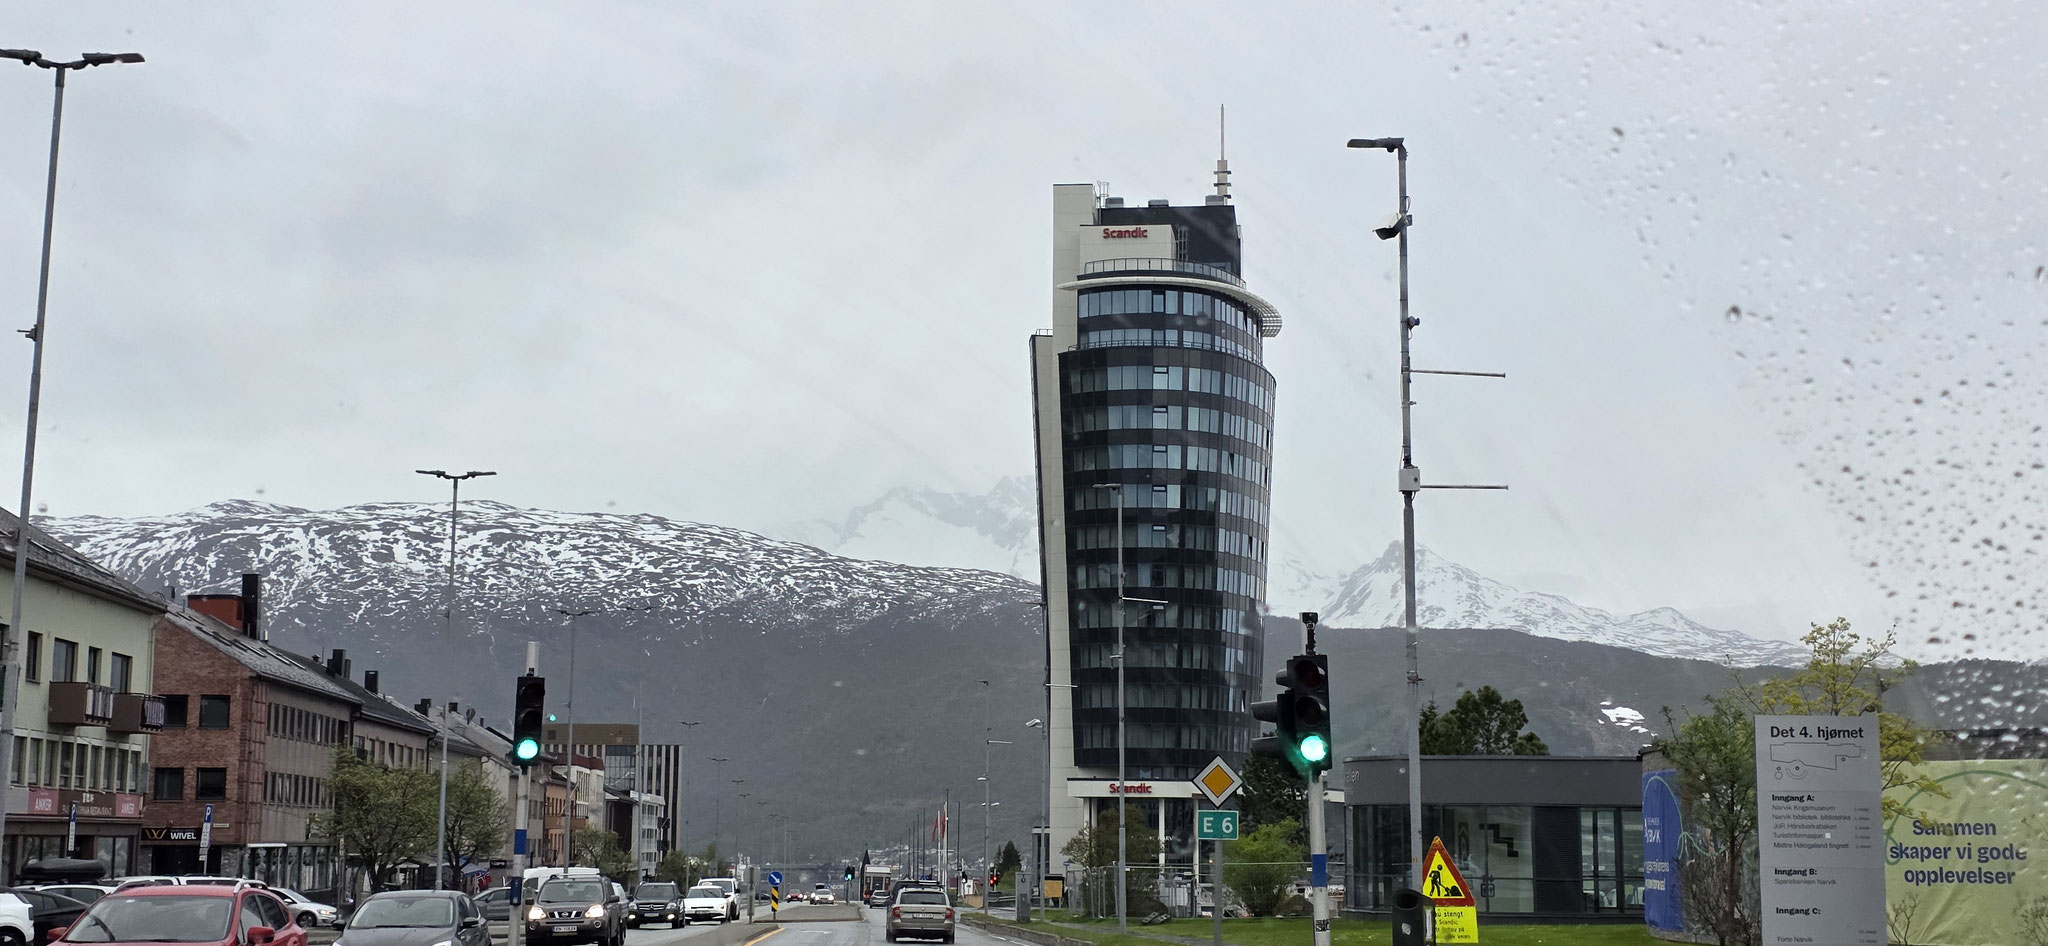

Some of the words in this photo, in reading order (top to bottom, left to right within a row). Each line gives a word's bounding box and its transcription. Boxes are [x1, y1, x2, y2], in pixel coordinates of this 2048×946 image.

[1103, 227, 1148, 239] Scandic
[1770, 726, 1794, 738] Det
[1799, 727, 1813, 738] 4.
[1817, 726, 1864, 740] hjørnet
[1772, 794, 1805, 802] Inngang
[1794, 804, 1835, 812] Krigsmuseum
[205, 806, 211, 821] P
[1203, 816, 1214, 833] E
[1221, 817, 1233, 834] 6
[1912, 819, 1997, 836] Sammen
[170, 832, 197, 840] WIVEL
[1773, 832, 1824, 840] Turistinformasjon
[1794, 842, 1828, 850] Hålogaland
[1890, 842, 1951, 862] skaper
[1955, 843, 1972, 860] vi
[1977, 842, 2028, 862] gode
[1774, 868, 1807, 877] Inngang
[1904, 866, 2016, 886] opplevelser
[1774, 878, 1816, 886] Sparebanken
[1776, 907, 1810, 915] Inngang
